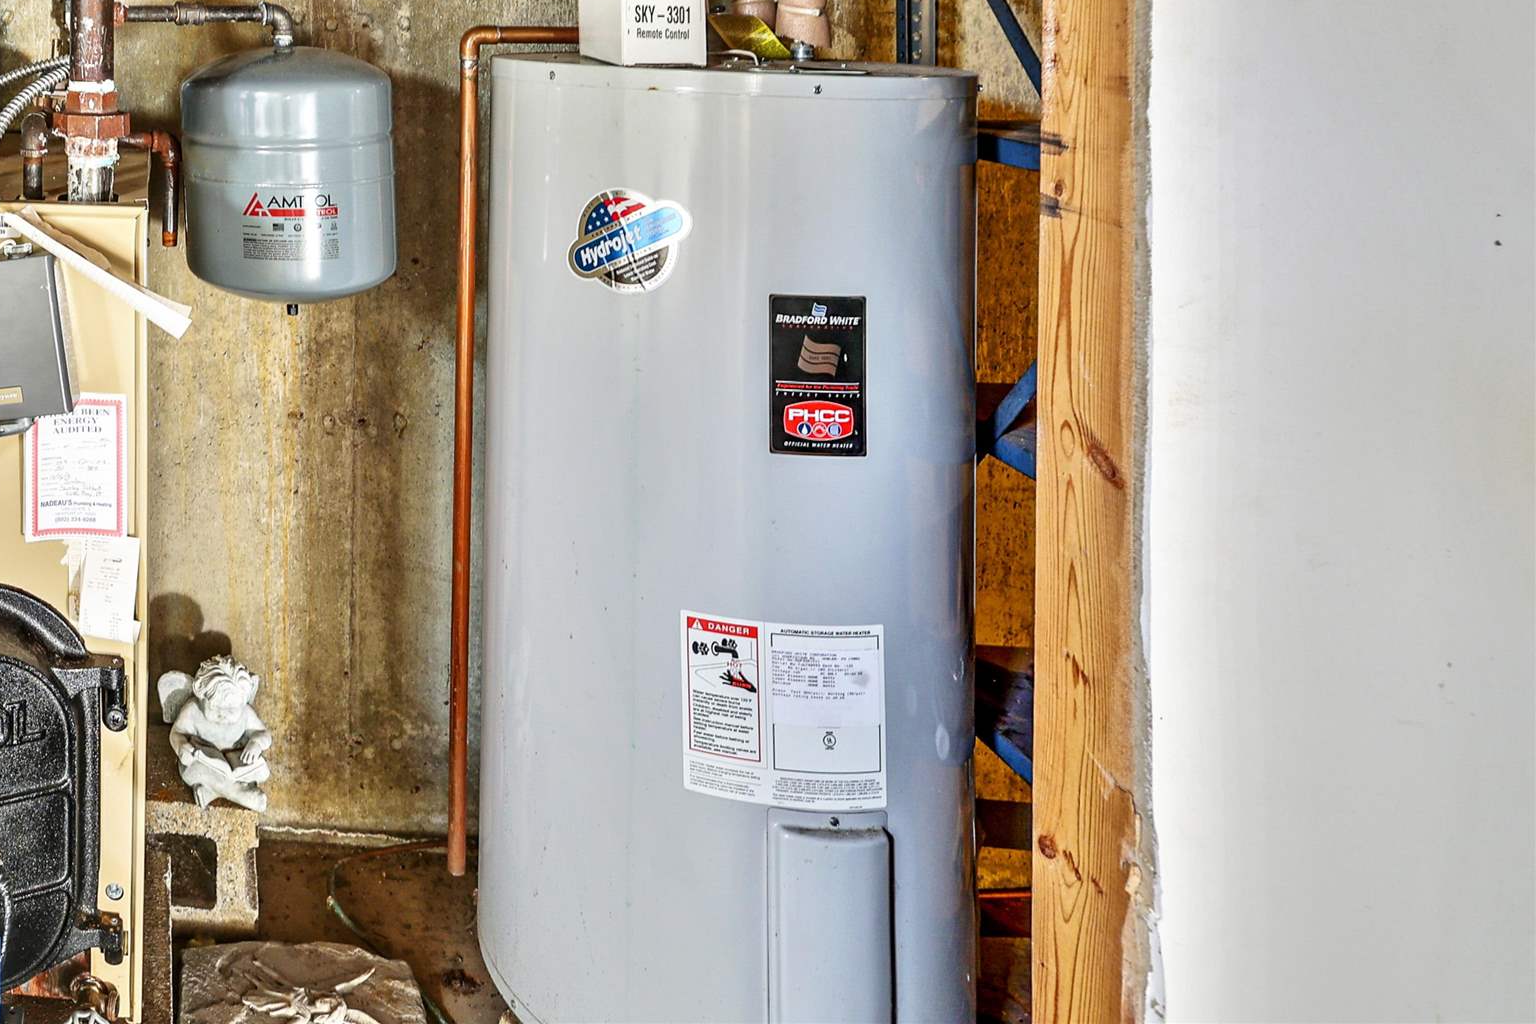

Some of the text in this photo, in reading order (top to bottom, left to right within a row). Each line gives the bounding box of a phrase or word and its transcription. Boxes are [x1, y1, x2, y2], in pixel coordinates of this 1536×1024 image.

[635, 5, 655, 23] SKY
[667, 6, 690, 24] 3301
[636, 27, 690, 39] Remote Control
[267, 194, 338, 208] AMTOL
[580, 224, 641, 267] Hydrojet
[775, 314, 860, 325] BRADFORD WHITE
[81, 408, 110, 416] BEEN
[788, 408, 850, 422] PHCC
[54, 417, 97, 426] ENERGY
[54, 426, 102, 434] AUDITED
[41, 499, 72, 508] NADEAU'S
[708, 623, 750, 635] DANGER
